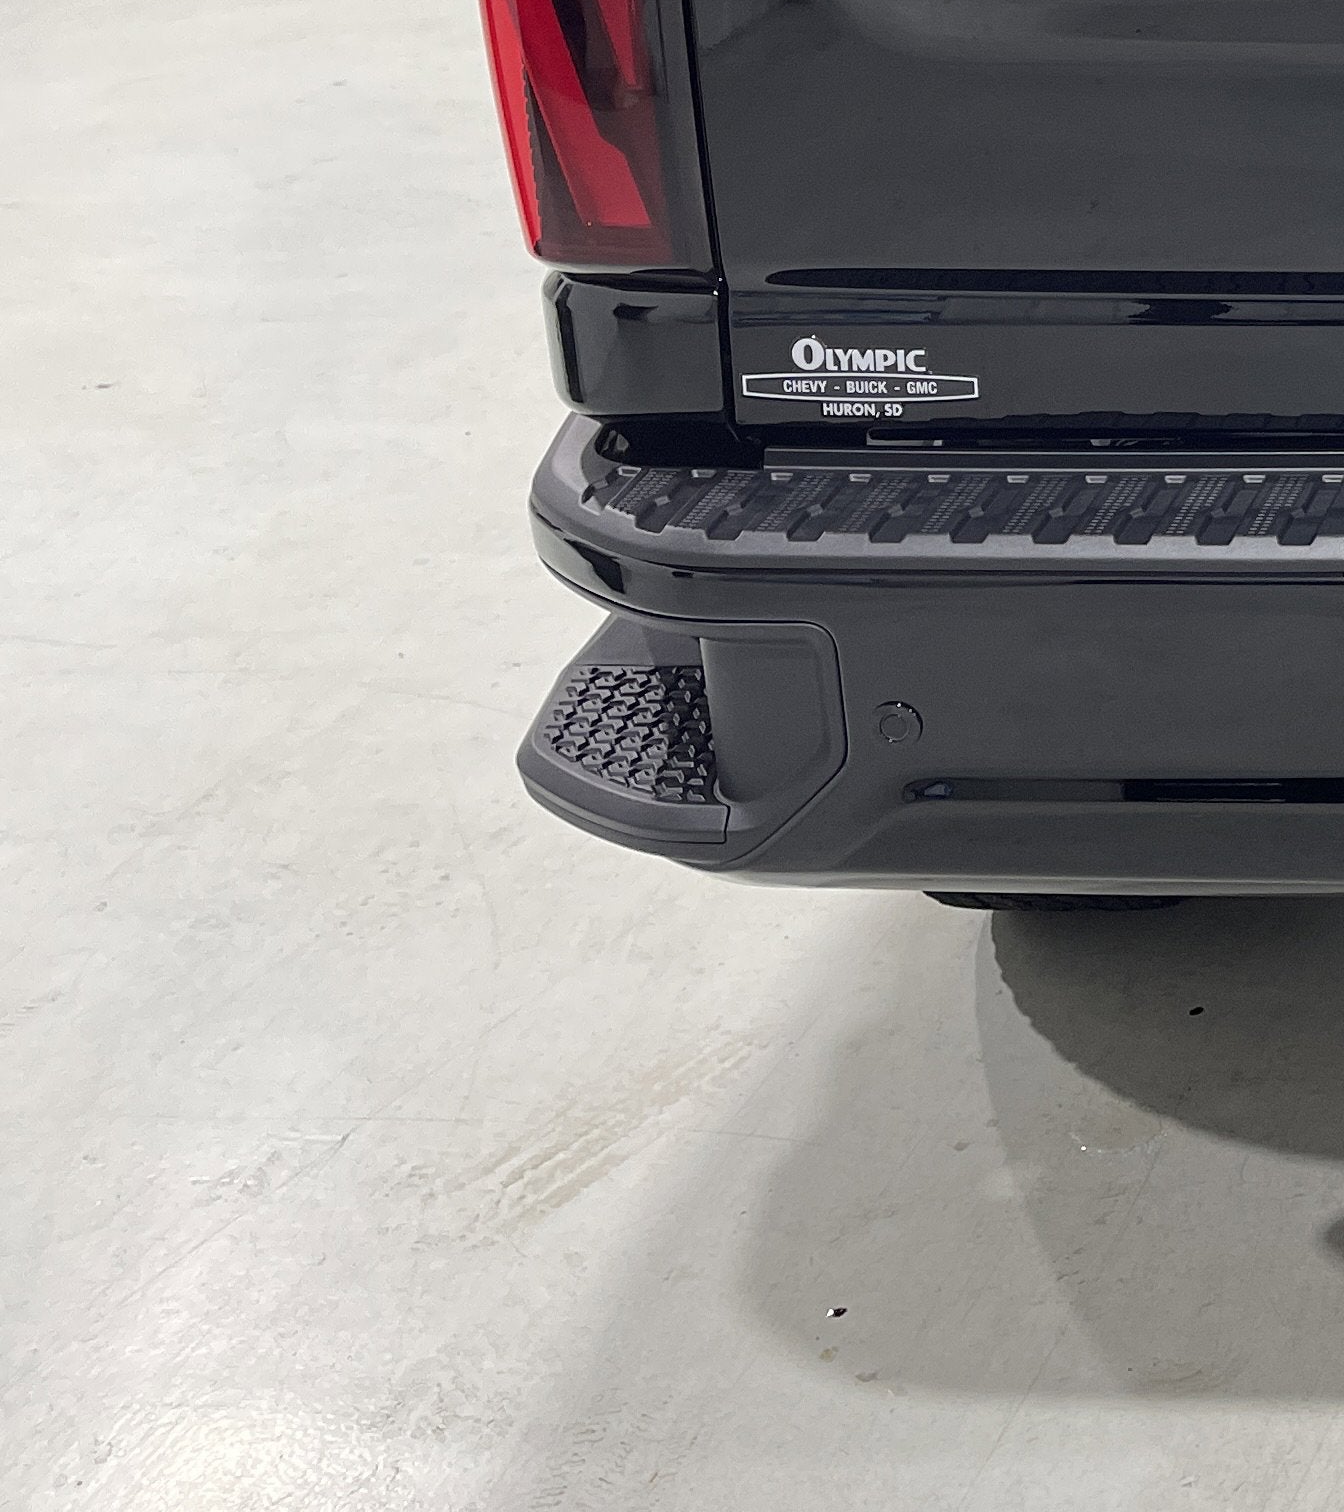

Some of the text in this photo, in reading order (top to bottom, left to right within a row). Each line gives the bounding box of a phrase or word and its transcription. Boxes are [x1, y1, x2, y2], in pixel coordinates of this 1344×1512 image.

[783, 380, 827, 394] CHEVY
[846, 380, 888, 395] BUICK
[906, 381, 938, 395] GMC
[822, 402, 903, 418] HURON, SD
